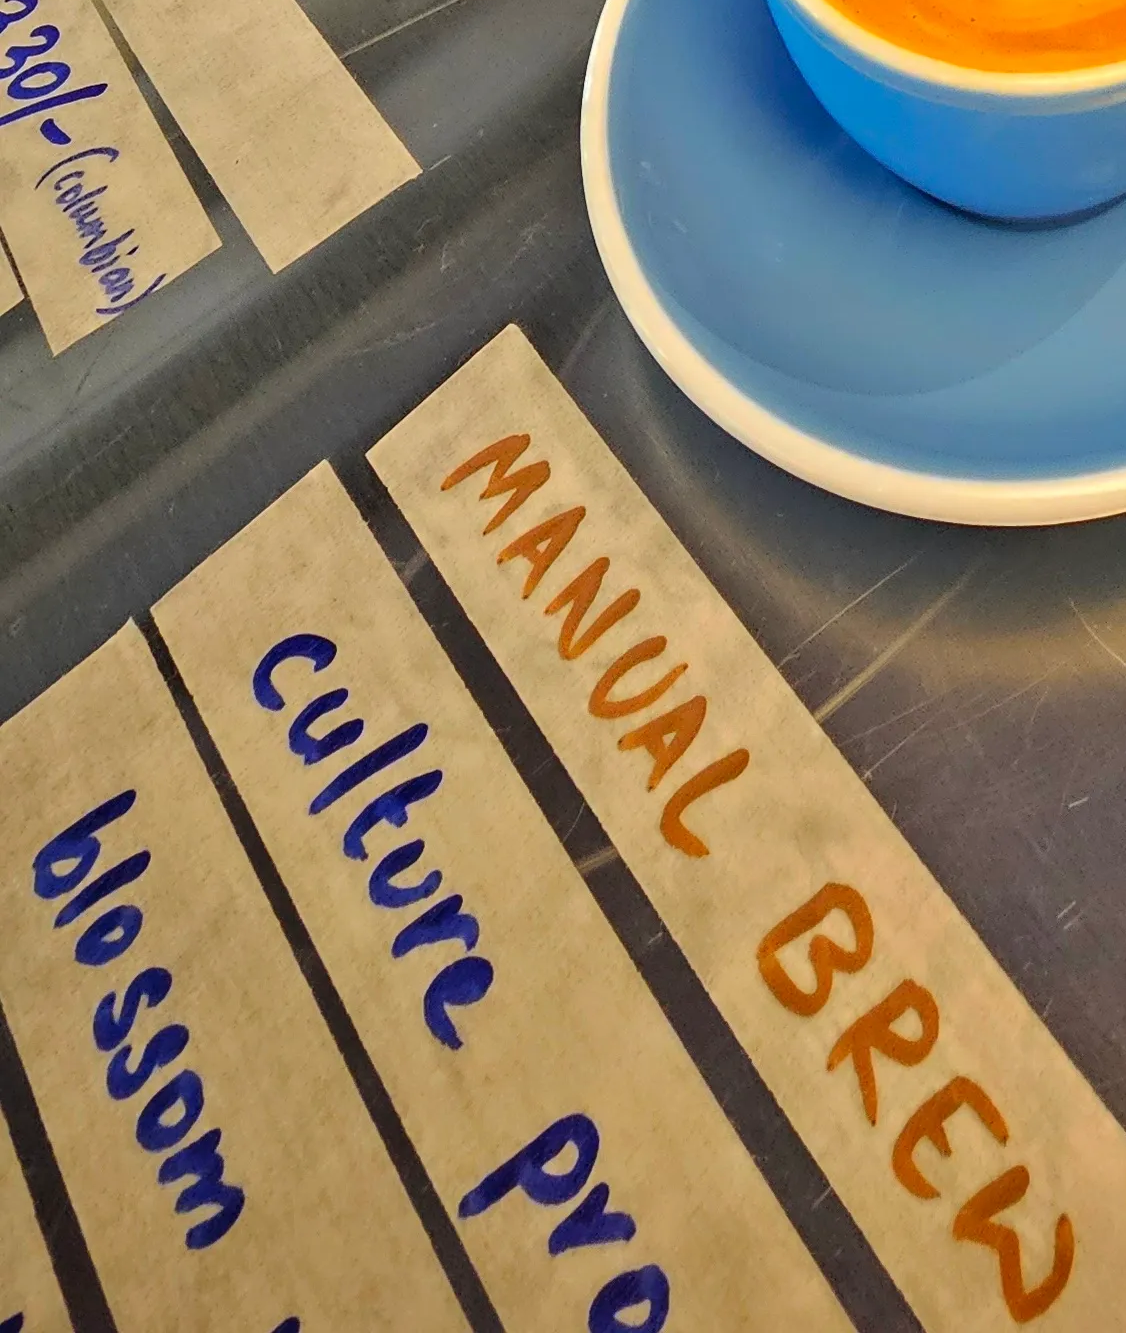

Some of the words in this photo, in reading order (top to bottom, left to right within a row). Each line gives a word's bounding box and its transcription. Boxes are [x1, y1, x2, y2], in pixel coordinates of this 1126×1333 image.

[33, 789, 246, 1250] blossom
[252, 633, 494, 1051] culture
[440, 432, 751, 860] MANUAL
[756, 882, 1077, 1325] BREW
